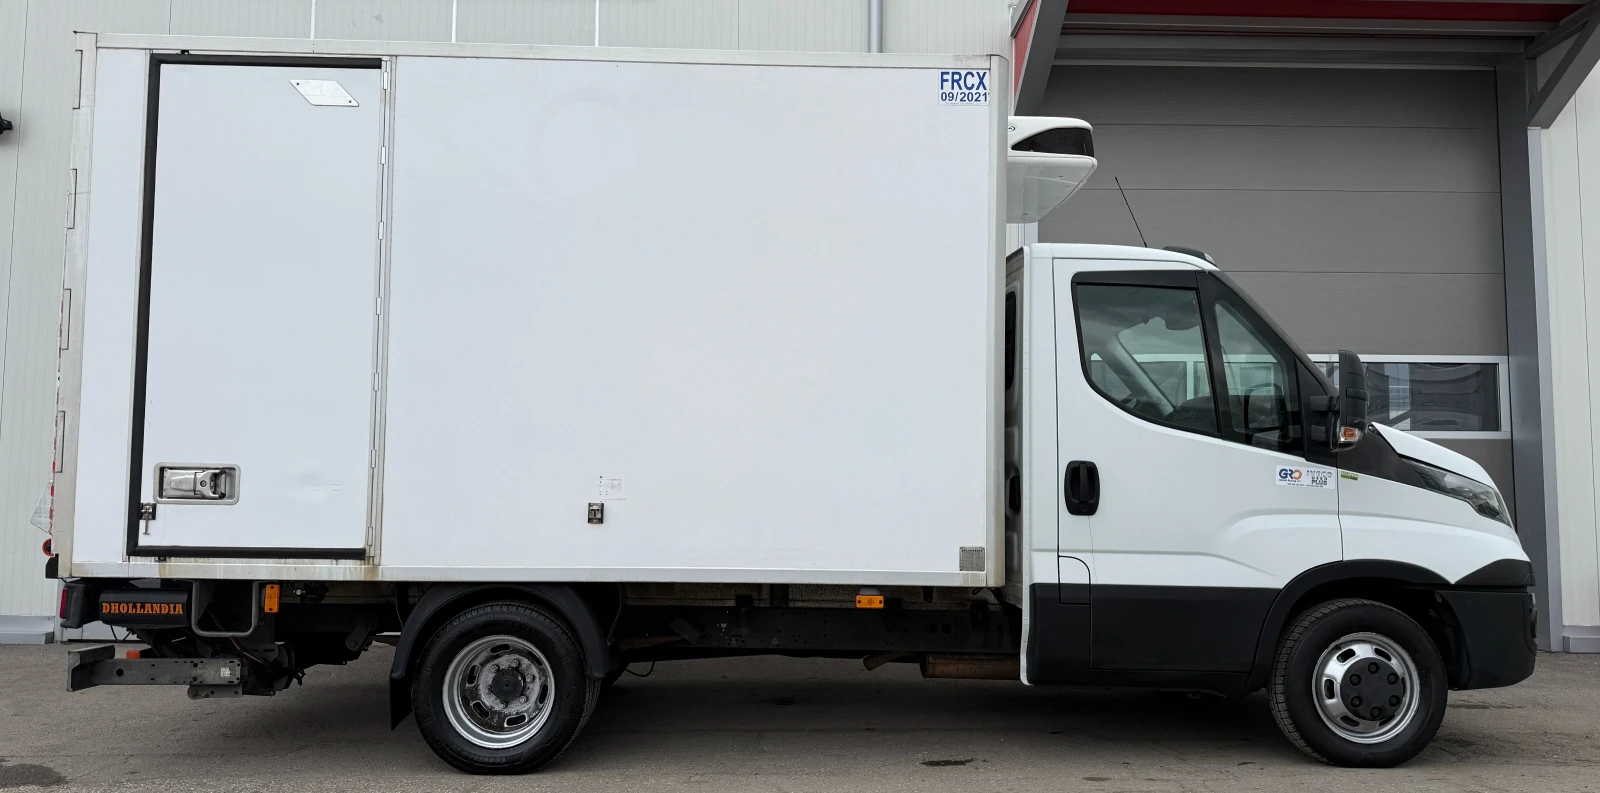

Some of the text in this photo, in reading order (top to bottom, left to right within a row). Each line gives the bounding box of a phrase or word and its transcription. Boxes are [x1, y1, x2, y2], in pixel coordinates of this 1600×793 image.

[940, 71, 987, 90] FRCX
[941, 92, 987, 102] 09/2021
[1278, 468, 1302, 481] GRO
[1306, 469, 1332, 478] IVECO
[101, 602, 183, 614] DHOLLANDIA
